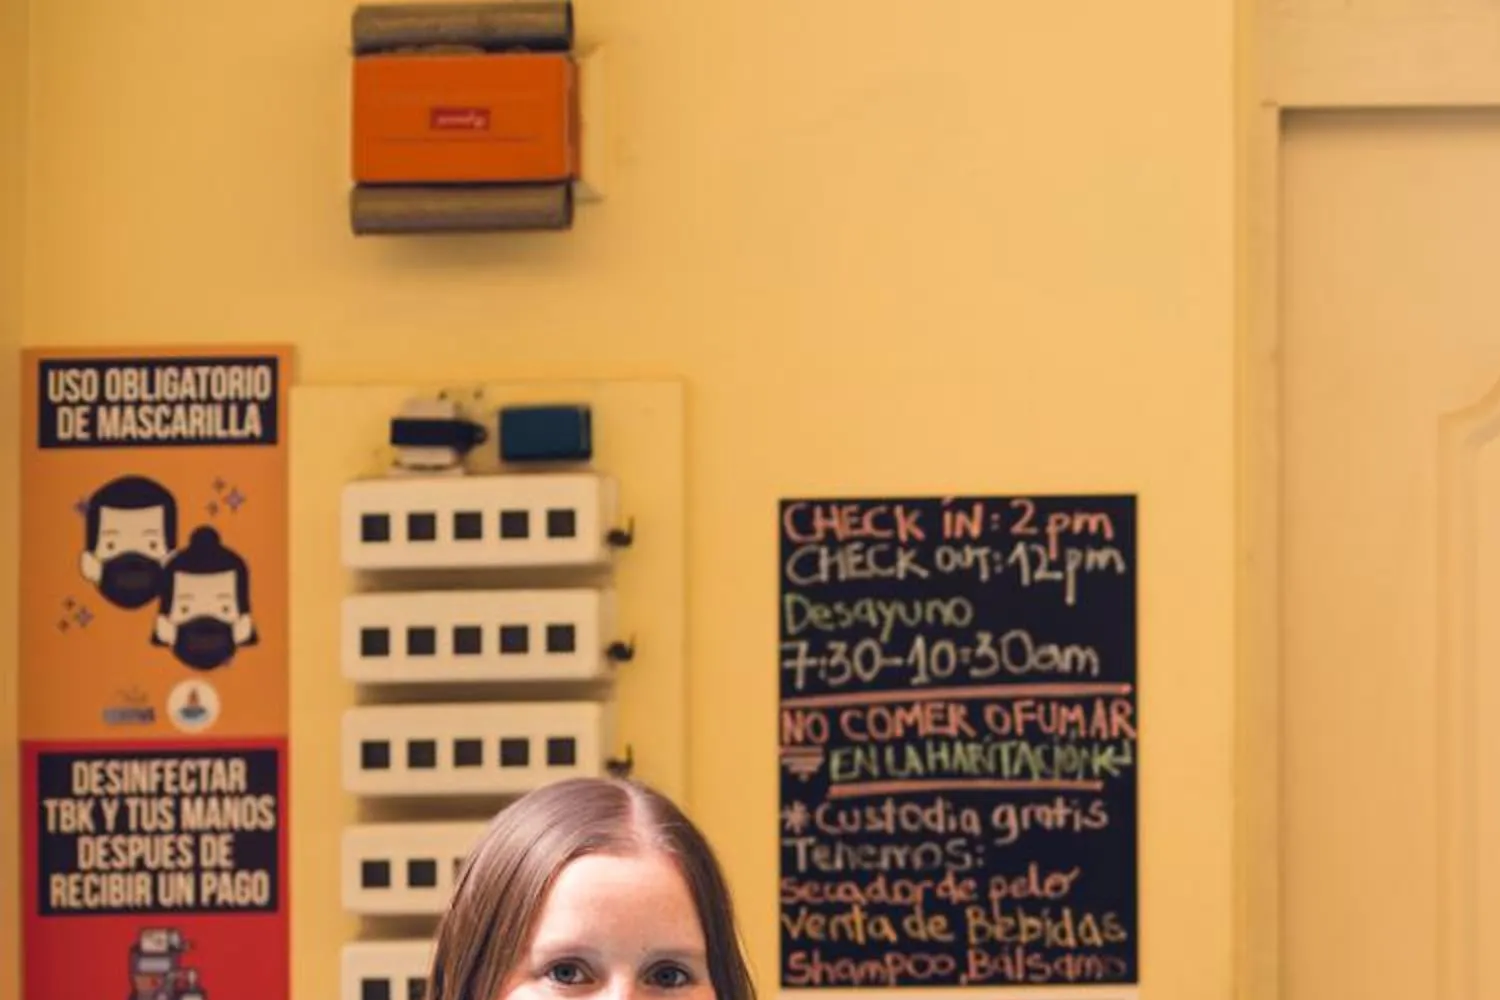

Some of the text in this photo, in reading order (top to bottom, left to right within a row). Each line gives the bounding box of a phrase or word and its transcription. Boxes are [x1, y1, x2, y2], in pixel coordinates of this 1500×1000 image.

[48, 364, 272, 402] USO OBLIGATORIO
[56, 402, 262, 440] DE MASCARILLA
[783, 503, 926, 543] CHECK
[785, 541, 930, 586] CHECK
[784, 593, 974, 643] Desayuno
[782, 708, 830, 747] NO
[839, 699, 978, 743] COMER
[71, 758, 247, 796] DESINFECTAR
[44, 794, 276, 834] TBK Y TUS MANOS
[991, 796, 1110, 846] gratis
[77, 832, 234, 870] DESPUES DE
[50, 868, 271, 909] RECIBIR UN PAGO
